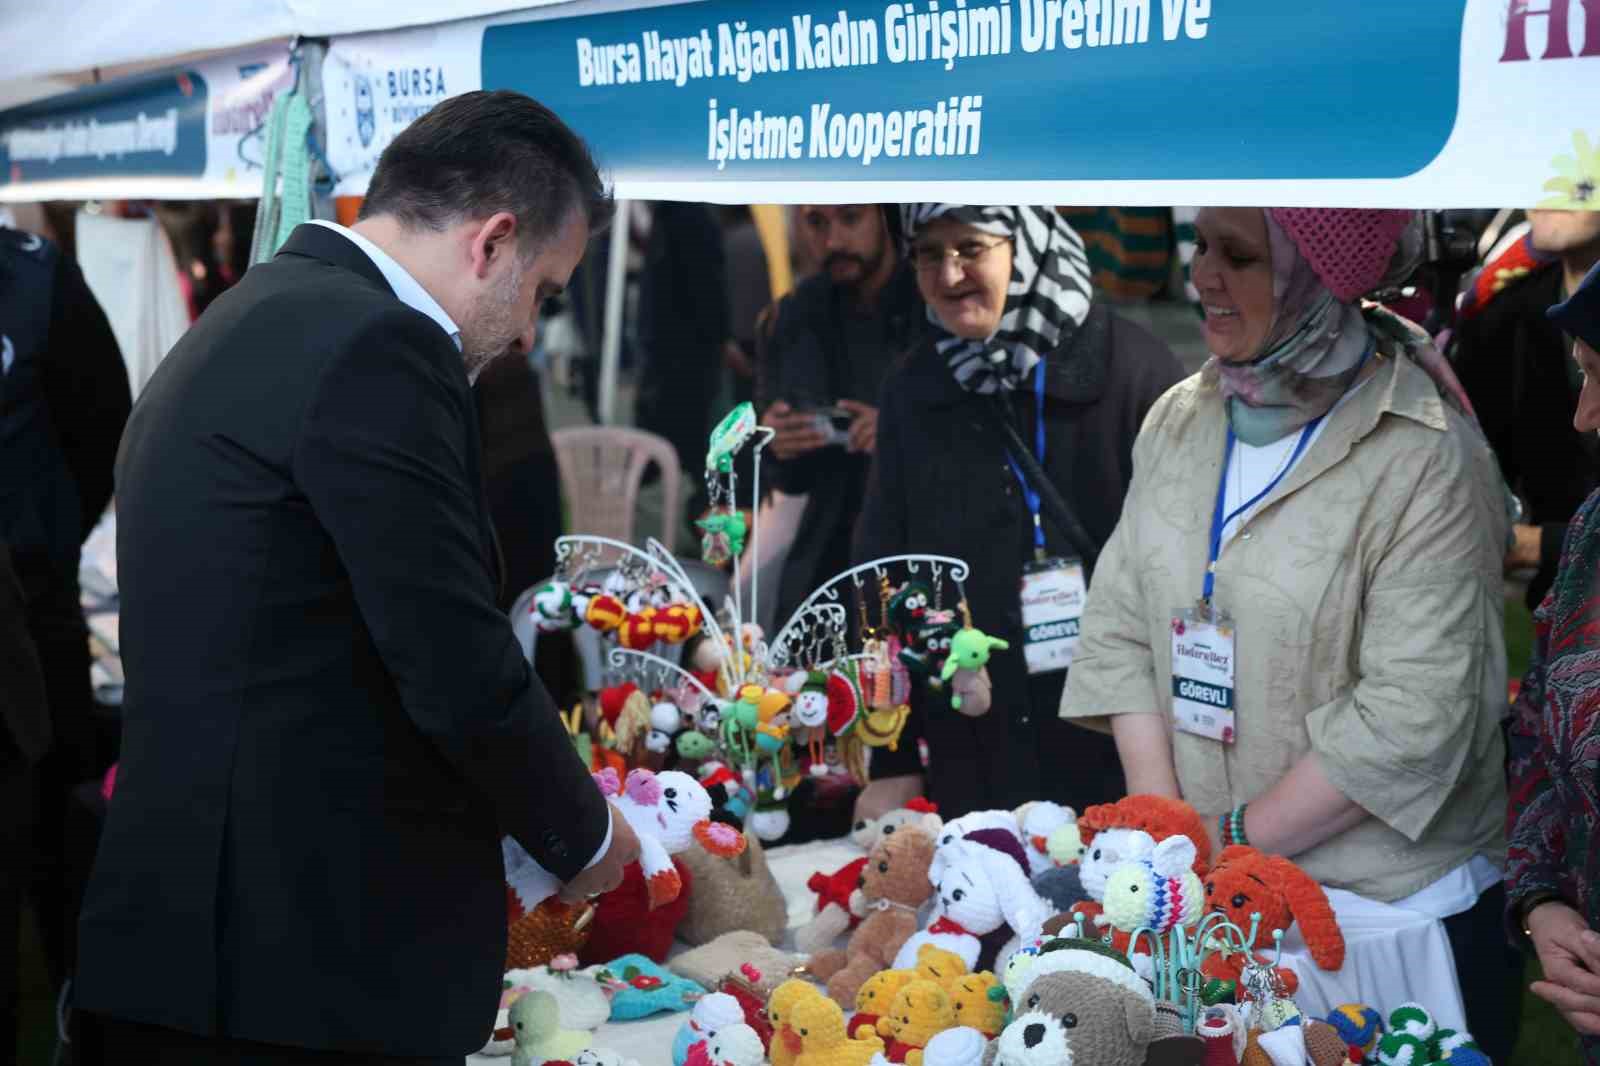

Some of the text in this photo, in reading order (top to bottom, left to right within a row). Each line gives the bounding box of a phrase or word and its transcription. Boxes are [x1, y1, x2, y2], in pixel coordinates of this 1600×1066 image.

[577, 37, 642, 87] Bursa
[642, 28, 714, 87] Hayat
[718, 20, 789, 83] Ağacı
[792, 10, 878, 72] Kadın
[884, 0, 1012, 71] Girişimi
[1162, 0, 1211, 41] ve
[387, 66, 446, 97] BURSA
[708, 95, 983, 171] İşletme Kooperatifi
[1029, 621, 1079, 641] GÖREVL
[1179, 681, 1228, 706] GÖREVLİ
